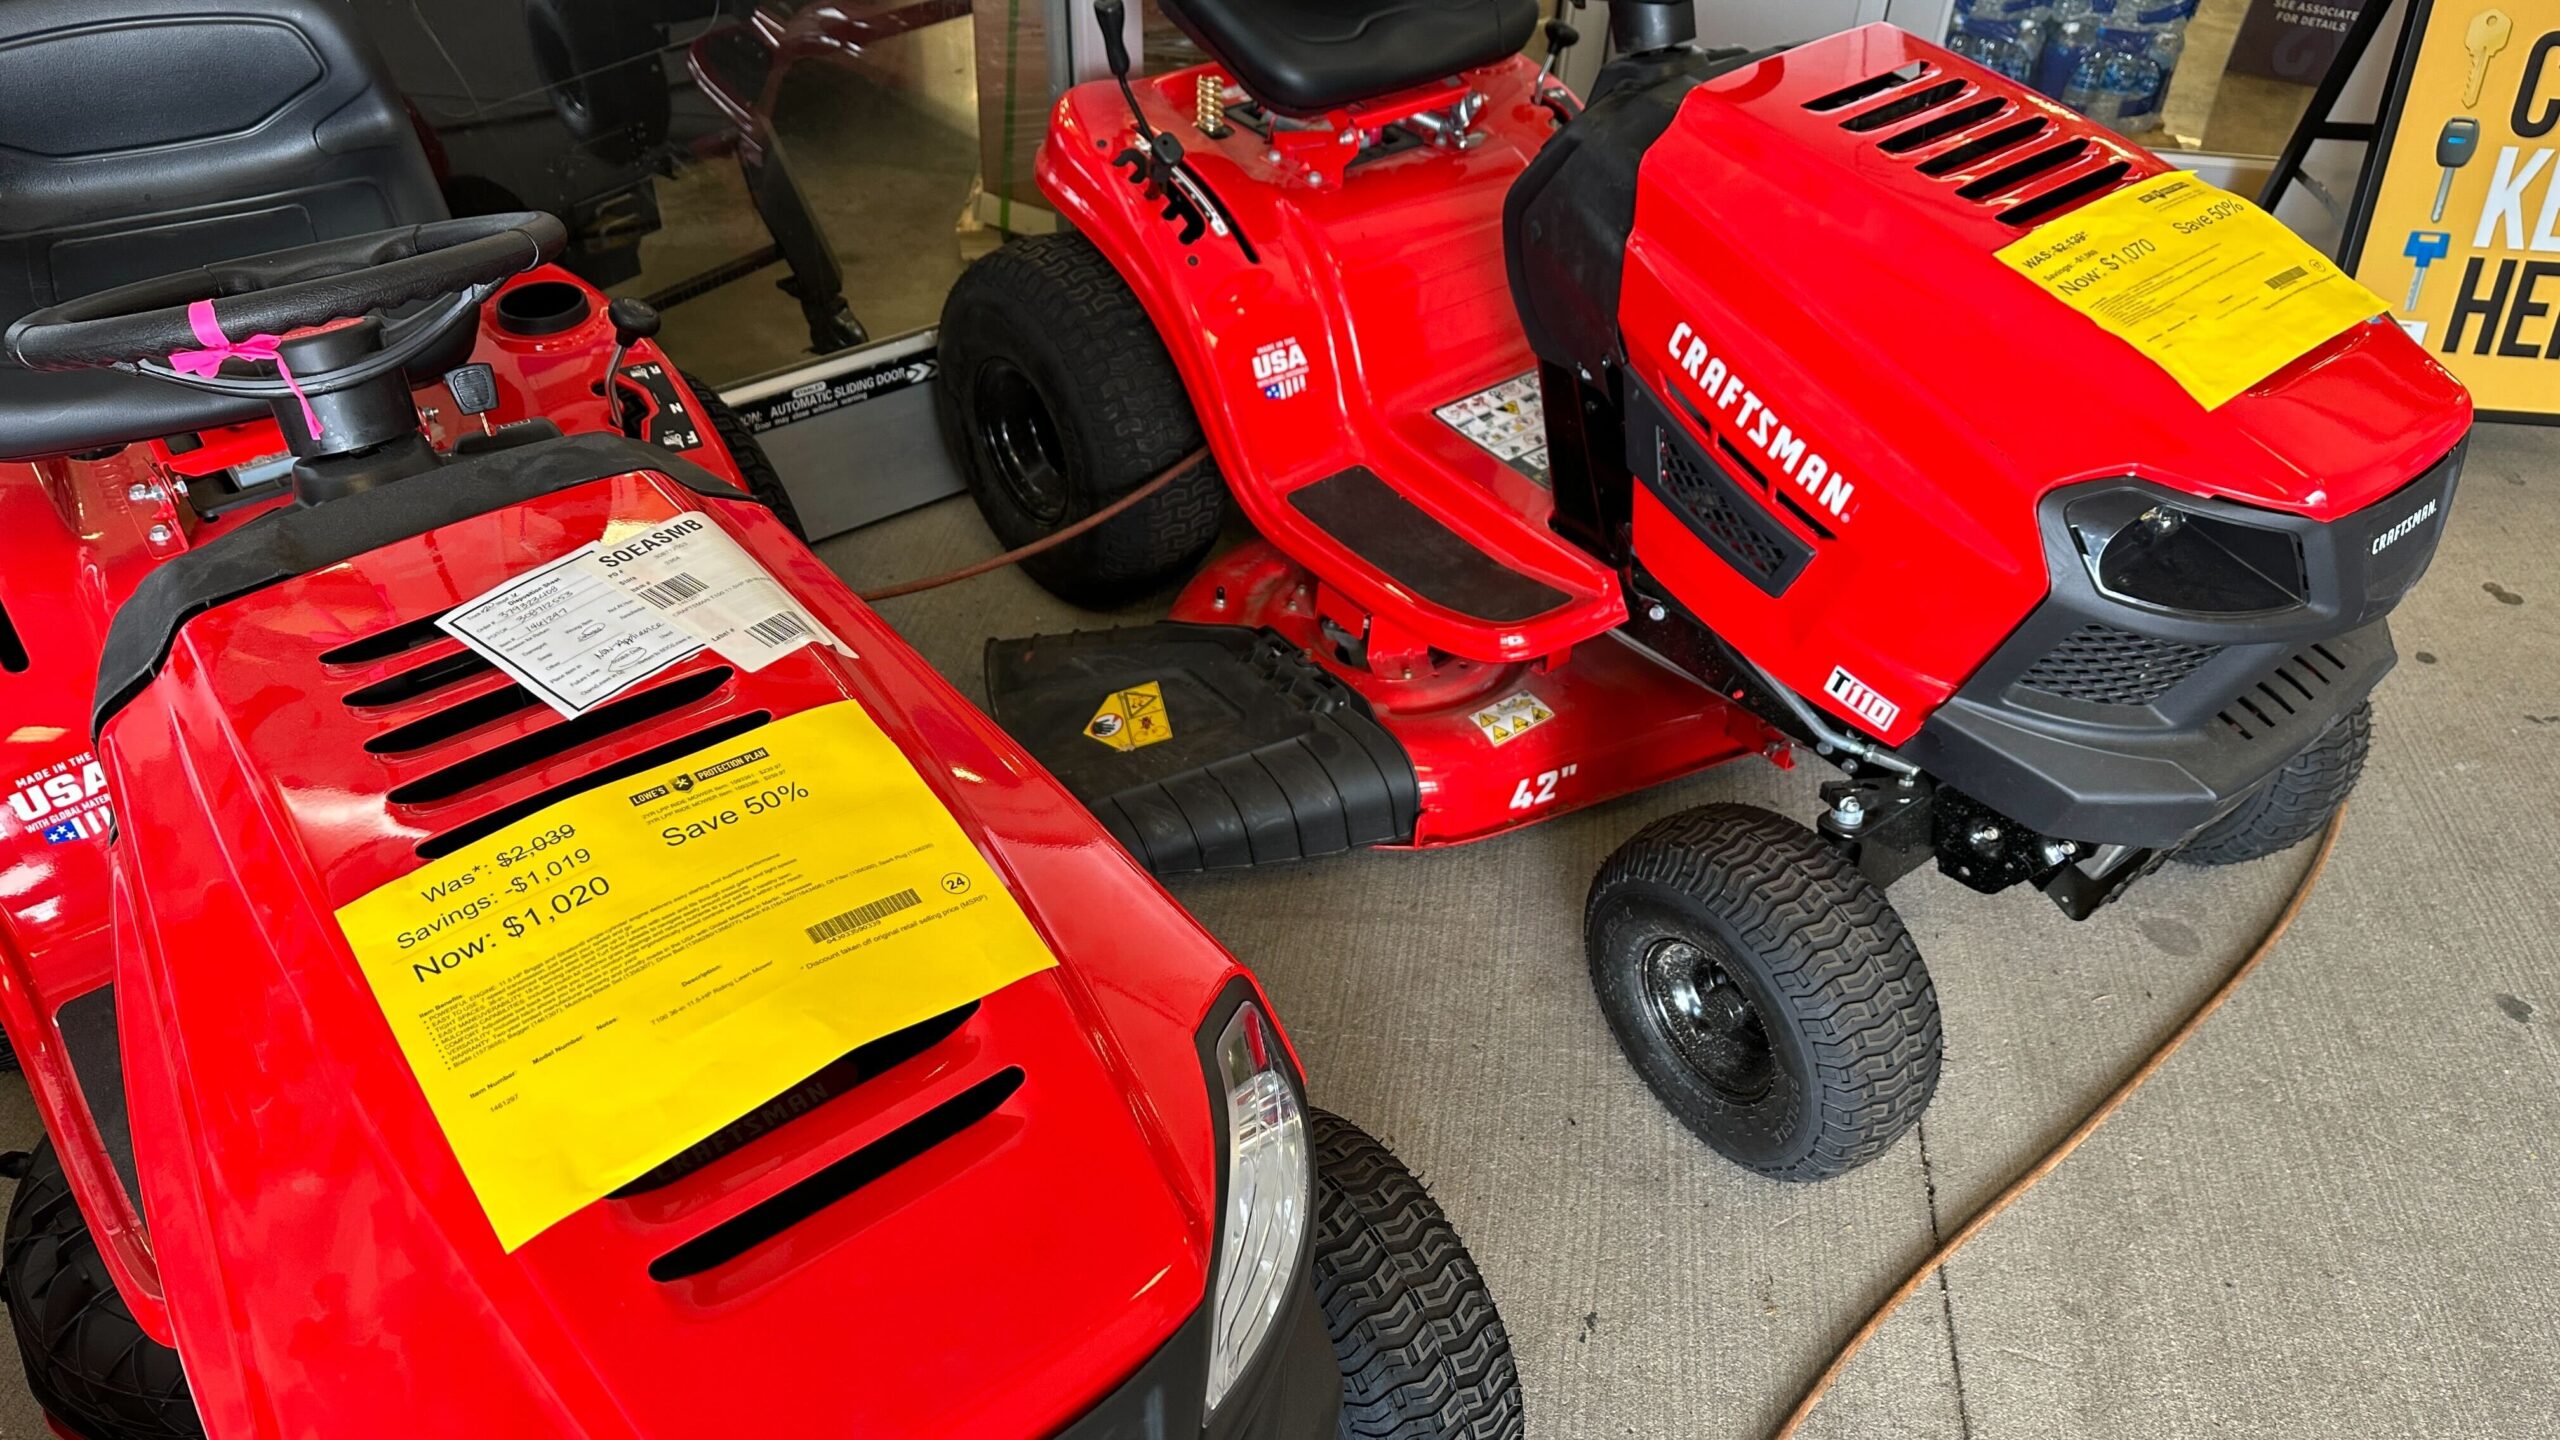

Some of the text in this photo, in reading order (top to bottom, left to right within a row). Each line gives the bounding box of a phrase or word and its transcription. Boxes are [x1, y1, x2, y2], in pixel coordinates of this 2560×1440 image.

[2276, 11, 2347, 32] FOR DETAILS
[2296, 1, 2360, 21] ASSOCIATE
[2172, 215, 2213, 235] Save
[2207, 199, 2245, 221] 50%
[2100, 238, 2156, 271] $1,070
[1252, 343, 1308, 380] USA
[770, 390, 833, 418] AUTOMATIC
[834, 376, 875, 399] SLIDING
[876, 367, 906, 387] DOOR
[1667, 321, 1856, 518] CRAFTSMAN
[598, 519, 704, 568] SOEASMB
[2372, 498, 2437, 556] CRAFTSMAN
[506, 585, 545, 606] Disposition
[1829, 668, 1896, 728] T110
[7, 760, 108, 821] USA
[15, 751, 93, 788] MADE IN THE
[632, 748, 767, 805] LOWE'S PROTECTION PLAN
[1509, 763, 1578, 809] 42"
[25, 819, 50, 834] WITH
[49, 805, 82, 824] GLOBAL
[661, 781, 810, 847] Save 50%
[496, 823, 576, 868] $2,039
[397, 848, 591, 950] Savings: -$1,019
[945, 876, 966, 891] 24
[412, 876, 610, 983] Now: $1,020
[806, 950, 841, 970] Discount
[840, 942, 862, 956] taken
[862, 937, 873, 947] off
[873, 929, 899, 942] original
[900, 920, 918, 932] retail
[918, 912, 942, 927] selling
[942, 904, 960, 917] price
[960, 894, 989, 911] (MSRP)
[531, 1050, 555, 1065] Model
[469, 1086, 487, 1099] Item
